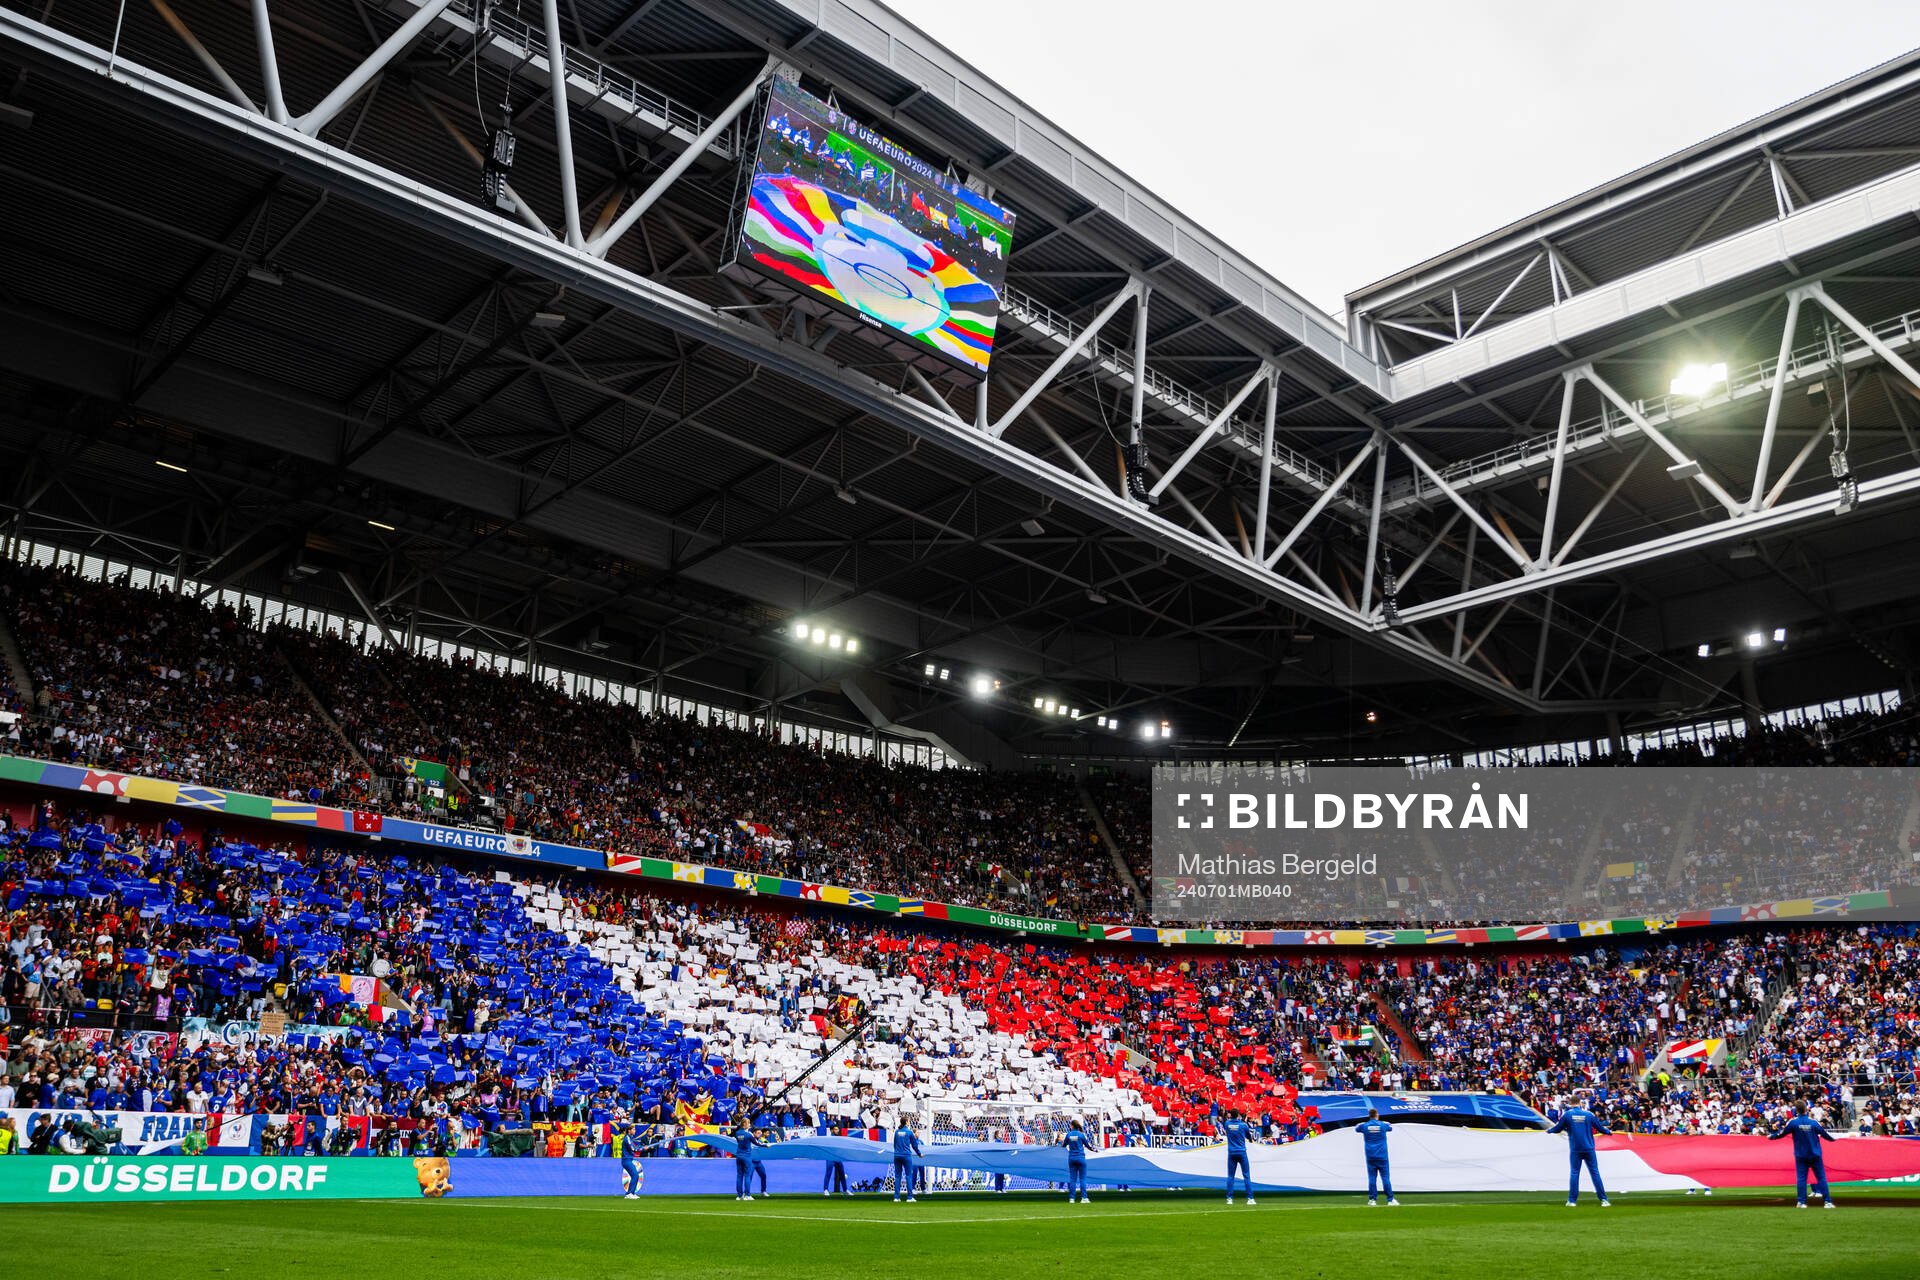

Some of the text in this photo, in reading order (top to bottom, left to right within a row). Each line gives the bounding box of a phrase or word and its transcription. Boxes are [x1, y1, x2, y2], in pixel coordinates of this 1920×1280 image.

[859, 312, 882, 328] Hisense
[429, 779, 440, 787] 122
[989, 914, 1058, 933] DÜSSELDORF
[48, 1156, 329, 1193] DÜSSELDORF
